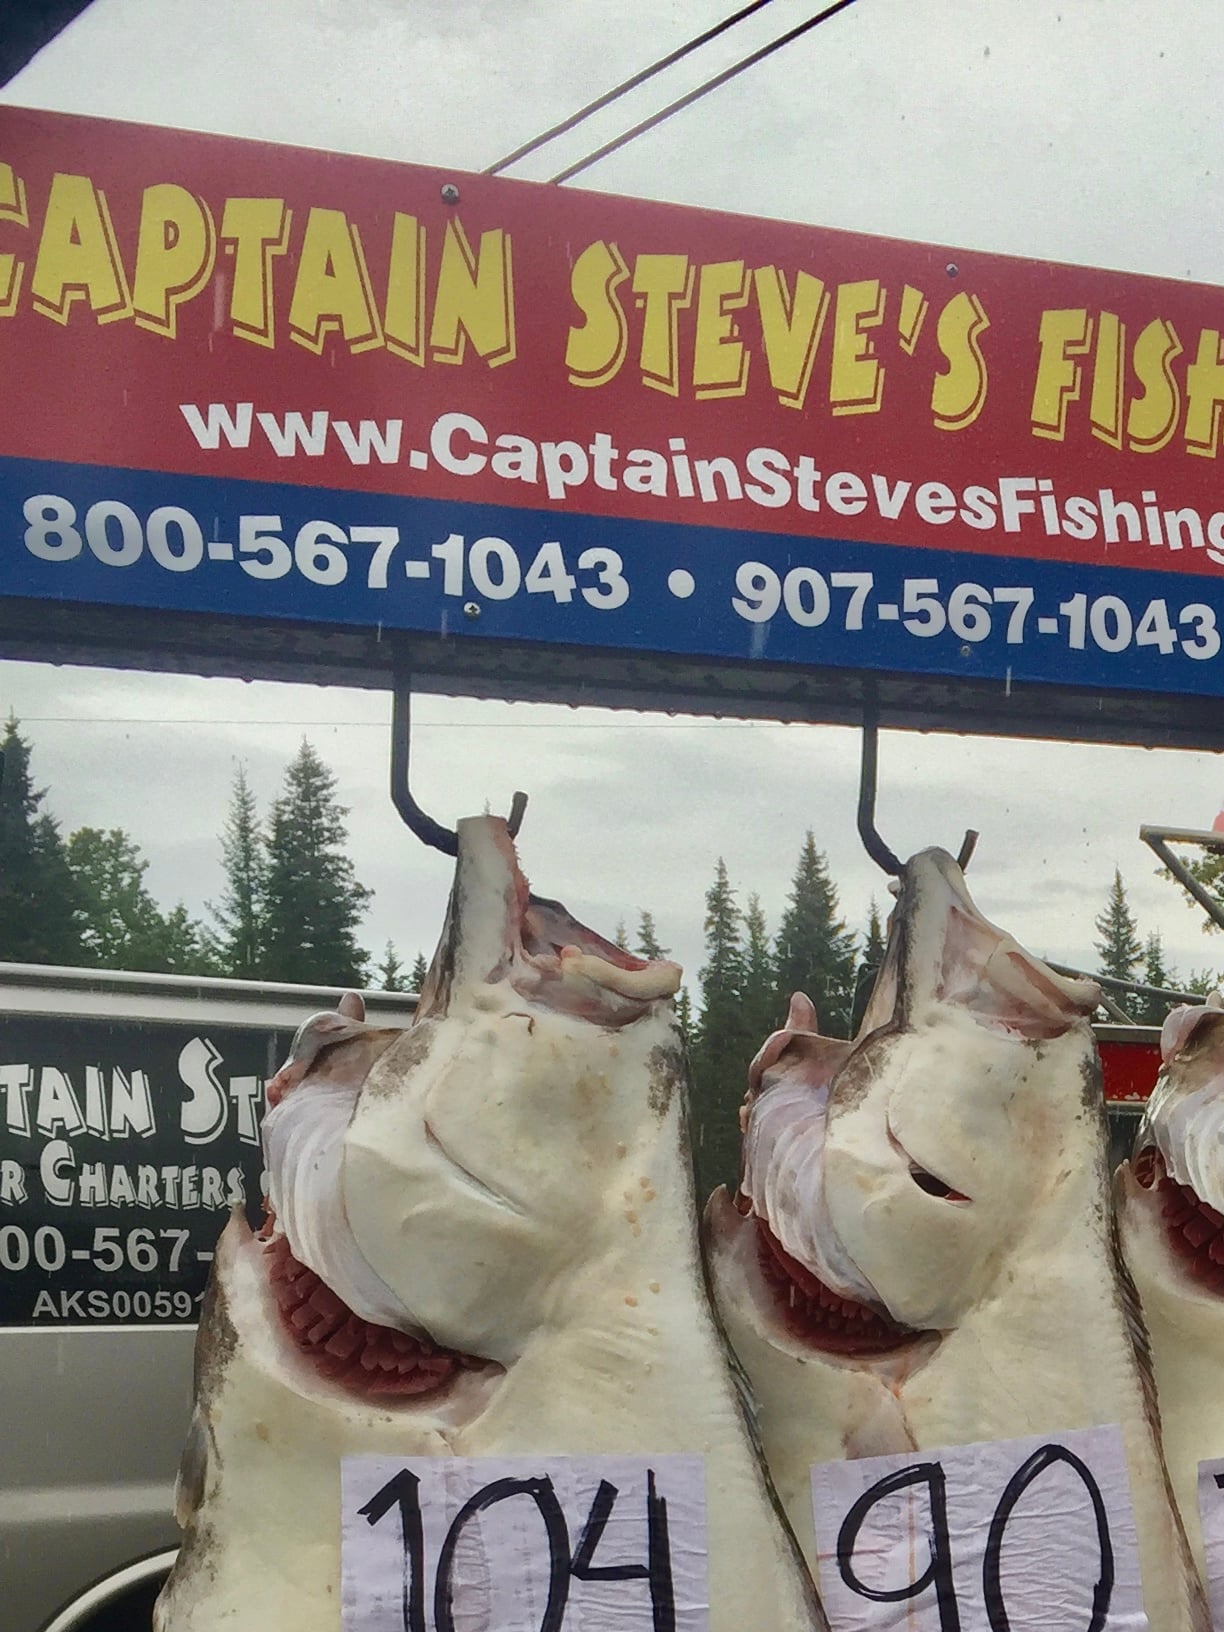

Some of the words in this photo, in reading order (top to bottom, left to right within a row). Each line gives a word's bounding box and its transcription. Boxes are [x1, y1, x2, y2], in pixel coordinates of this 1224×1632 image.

[566, 240, 990, 432] STEVE'S
[22, 494, 629, 610] 800-567-1043
[732, 562, 1222, 661] 907-567-1043
[0, 1063, 157, 1141] TAIN
[178, 1036, 271, 1147] ST
[40, 1139, 246, 1213] CHARTERS
